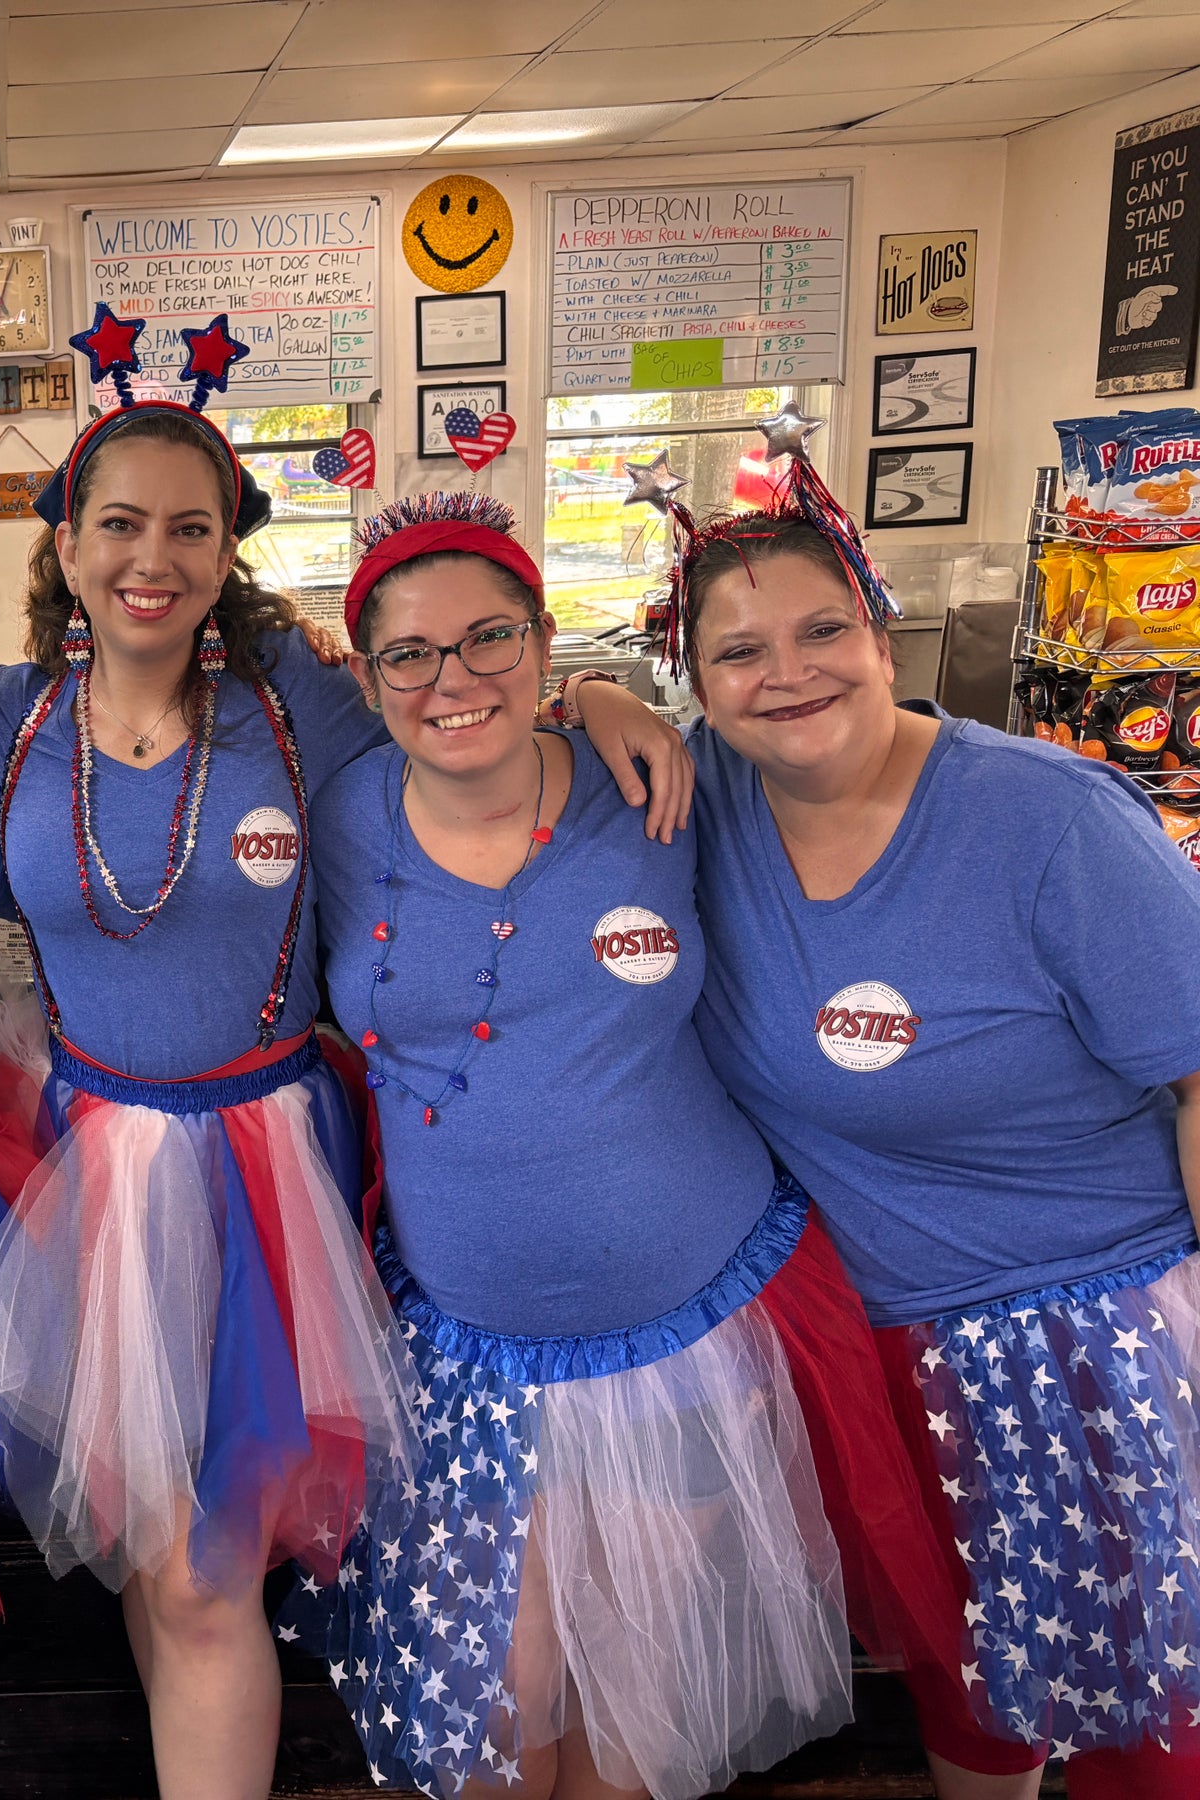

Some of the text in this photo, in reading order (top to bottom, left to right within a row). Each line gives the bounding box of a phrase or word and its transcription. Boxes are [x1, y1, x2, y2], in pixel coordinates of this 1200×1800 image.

[1130, 145, 1188, 180] IF YOU
[574, 193, 794, 227] PEPPERONI ROLL
[1125, 199, 1185, 231] STAND
[11, 224, 37, 242] PINT
[96, 205, 371, 255] WELCOME TO YOSTIES!
[573, 229, 616, 248] FRESH
[621, 228, 655, 245] YEAST
[659, 226, 686, 243] ROLL
[772, 224, 811, 239] BAKED
[817, 226, 832, 239] IN
[1135, 227, 1171, 253] THE
[95, 252, 361, 279] OUR DELICIOUS HOT DOG CHILI
[568, 254, 609, 271] PLAIN
[1126, 252, 1175, 280] HEAT
[27, 276, 36, 289] 2
[100, 281, 114, 296] IS
[120, 280, 158, 295] MADE
[165, 277, 207, 293] FRESH
[316, 271, 356, 286] HERE.
[566, 270, 732, 292] TOASTED W/ MOZZARELLA
[882, 241, 968, 325] HOT DOGS
[33, 294, 41, 307] 3
[120, 297, 155, 314] MILD
[159, 297, 171, 312] IS
[250, 291, 291, 308] SPICY
[293, 292, 305, 306] IS
[566, 290, 699, 307] WITH CHEESE CHILI
[29, 314, 37, 326] 4
[280, 313, 299, 331] 20
[564, 304, 718, 323] WITH CHEESE MARINARA
[16, 328, 24, 341] 5
[247, 325, 274, 344] TEA
[567, 326, 605, 342] CHILI
[610, 324, 674, 340] SPAGHETTI
[758, 319, 807, 331] CHEESES
[0, 336, 6, 347] 6
[282, 336, 328, 356] GALLON
[633, 343, 658, 355] BAG
[1108, 345, 1120, 354] GET
[1120, 343, 1132, 352] OUT
[1141, 341, 1153, 350] THE
[1153, 337, 1181, 348] KITCHEN
[566, 347, 626, 362] PINT WITH
[652, 351, 670, 364] OF
[128, 369, 169, 382] COLD
[241, 364, 280, 378] SODA
[563, 371, 604, 387] QUART
[660, 359, 714, 384] CHIPS
[908, 370, 939, 380] ServSafe
[432, 391, 468, 399] SANITATION
[432, 401, 445, 416] A
[904, 465, 936, 473] ServSafe
[6, 476, 50, 496] Groov
[1139, 581, 1194, 611] Lay's
[1143, 622, 1182, 635] Classic
[590, 927, 680, 962] YOSTIES
[813, 1006, 922, 1045] YOSTIES
